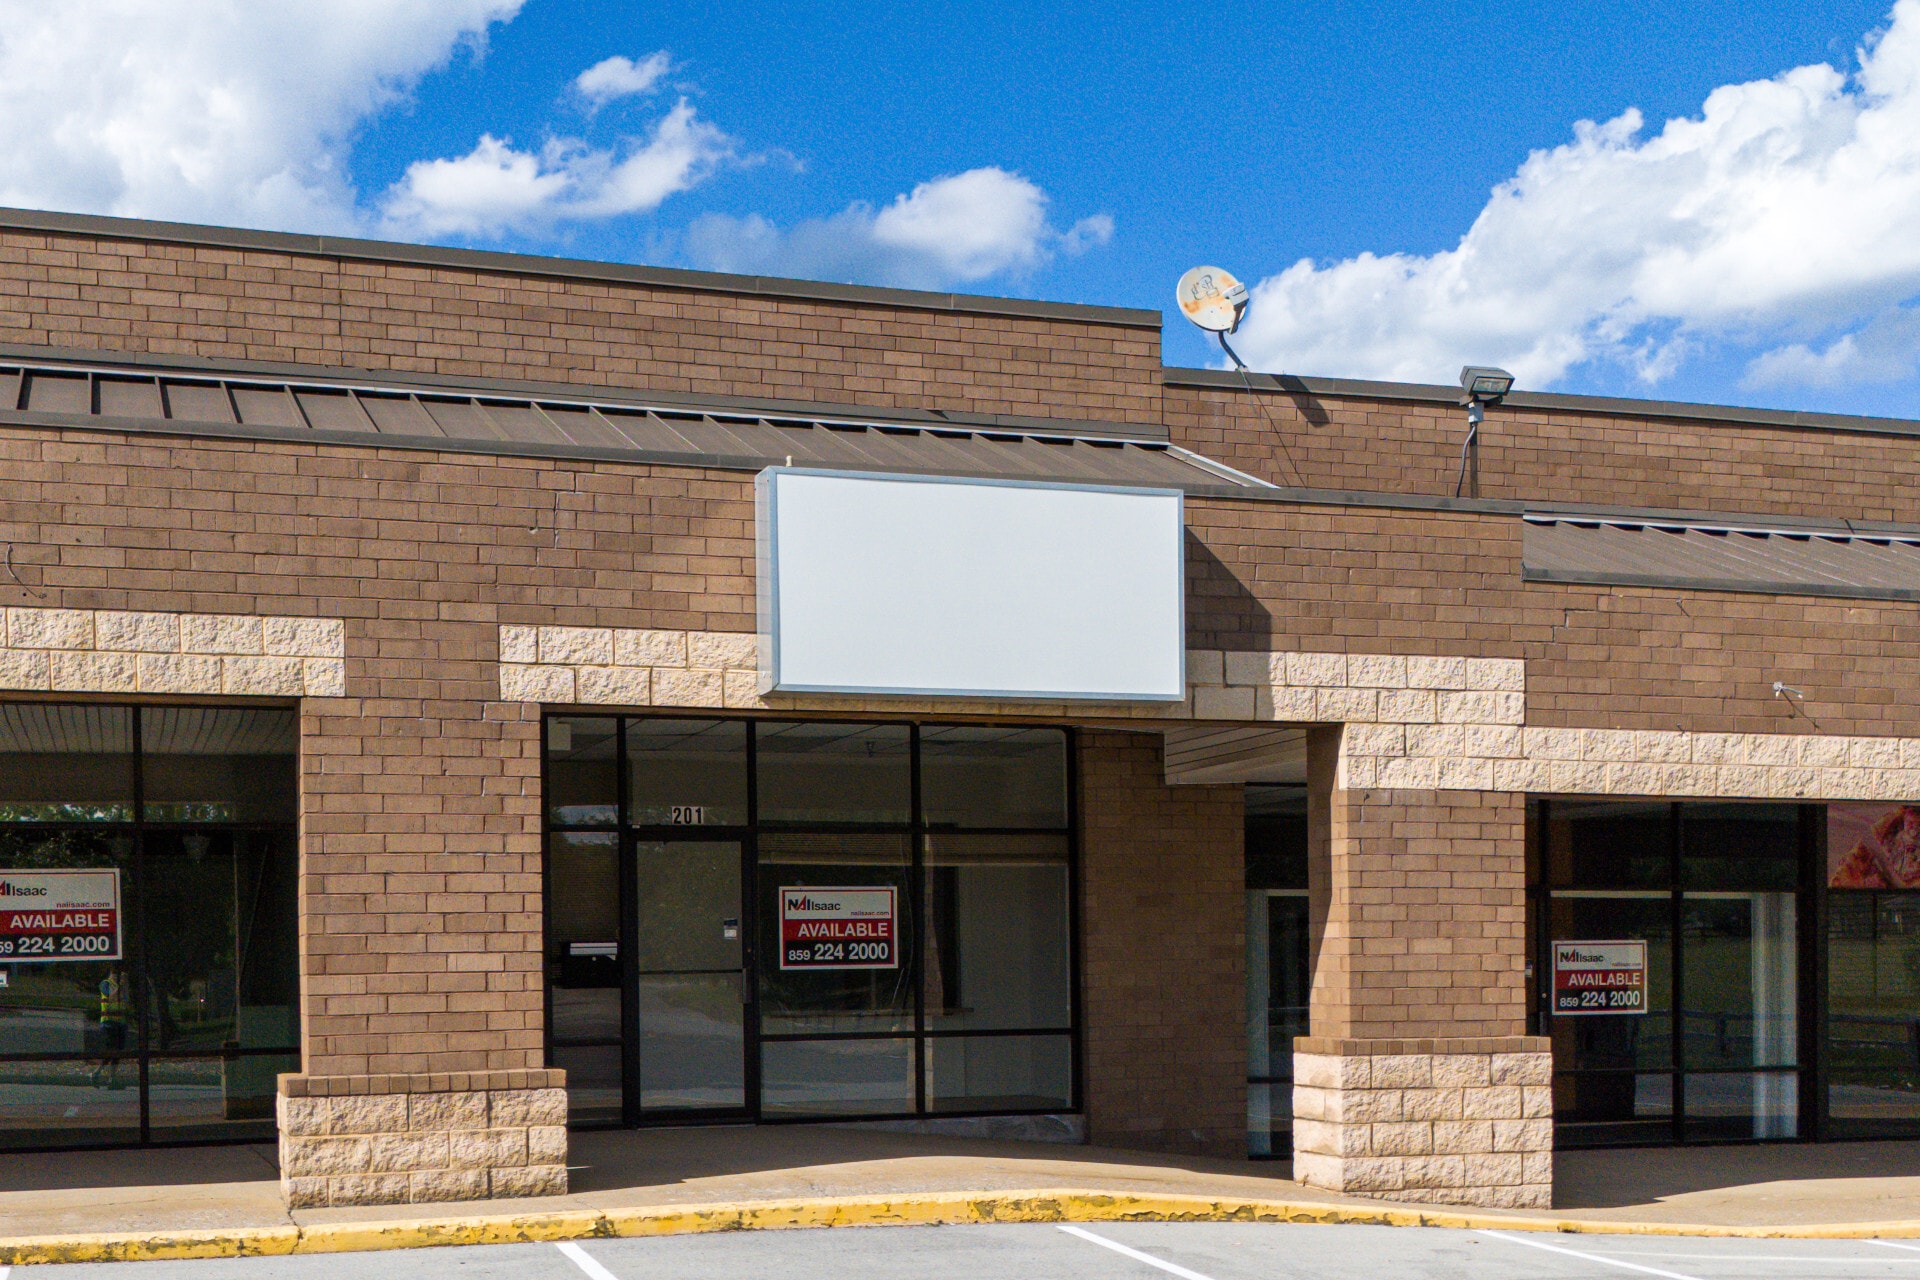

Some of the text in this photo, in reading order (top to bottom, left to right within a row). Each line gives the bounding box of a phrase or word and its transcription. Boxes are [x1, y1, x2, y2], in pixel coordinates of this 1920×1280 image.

[673, 807, 702, 825] 201
[12, 886, 48, 896] Isaac
[10, 913, 110, 928] AVAILABLE
[798, 923, 889, 937] AVAILABLE
[18, 936, 55, 953] 224
[61, 935, 110, 952] 2000
[788, 943, 889, 961] 859 224 2000
[1568, 973, 1641, 986] AVAILABLE
[1560, 990, 1640, 1007] 859 224 2000
